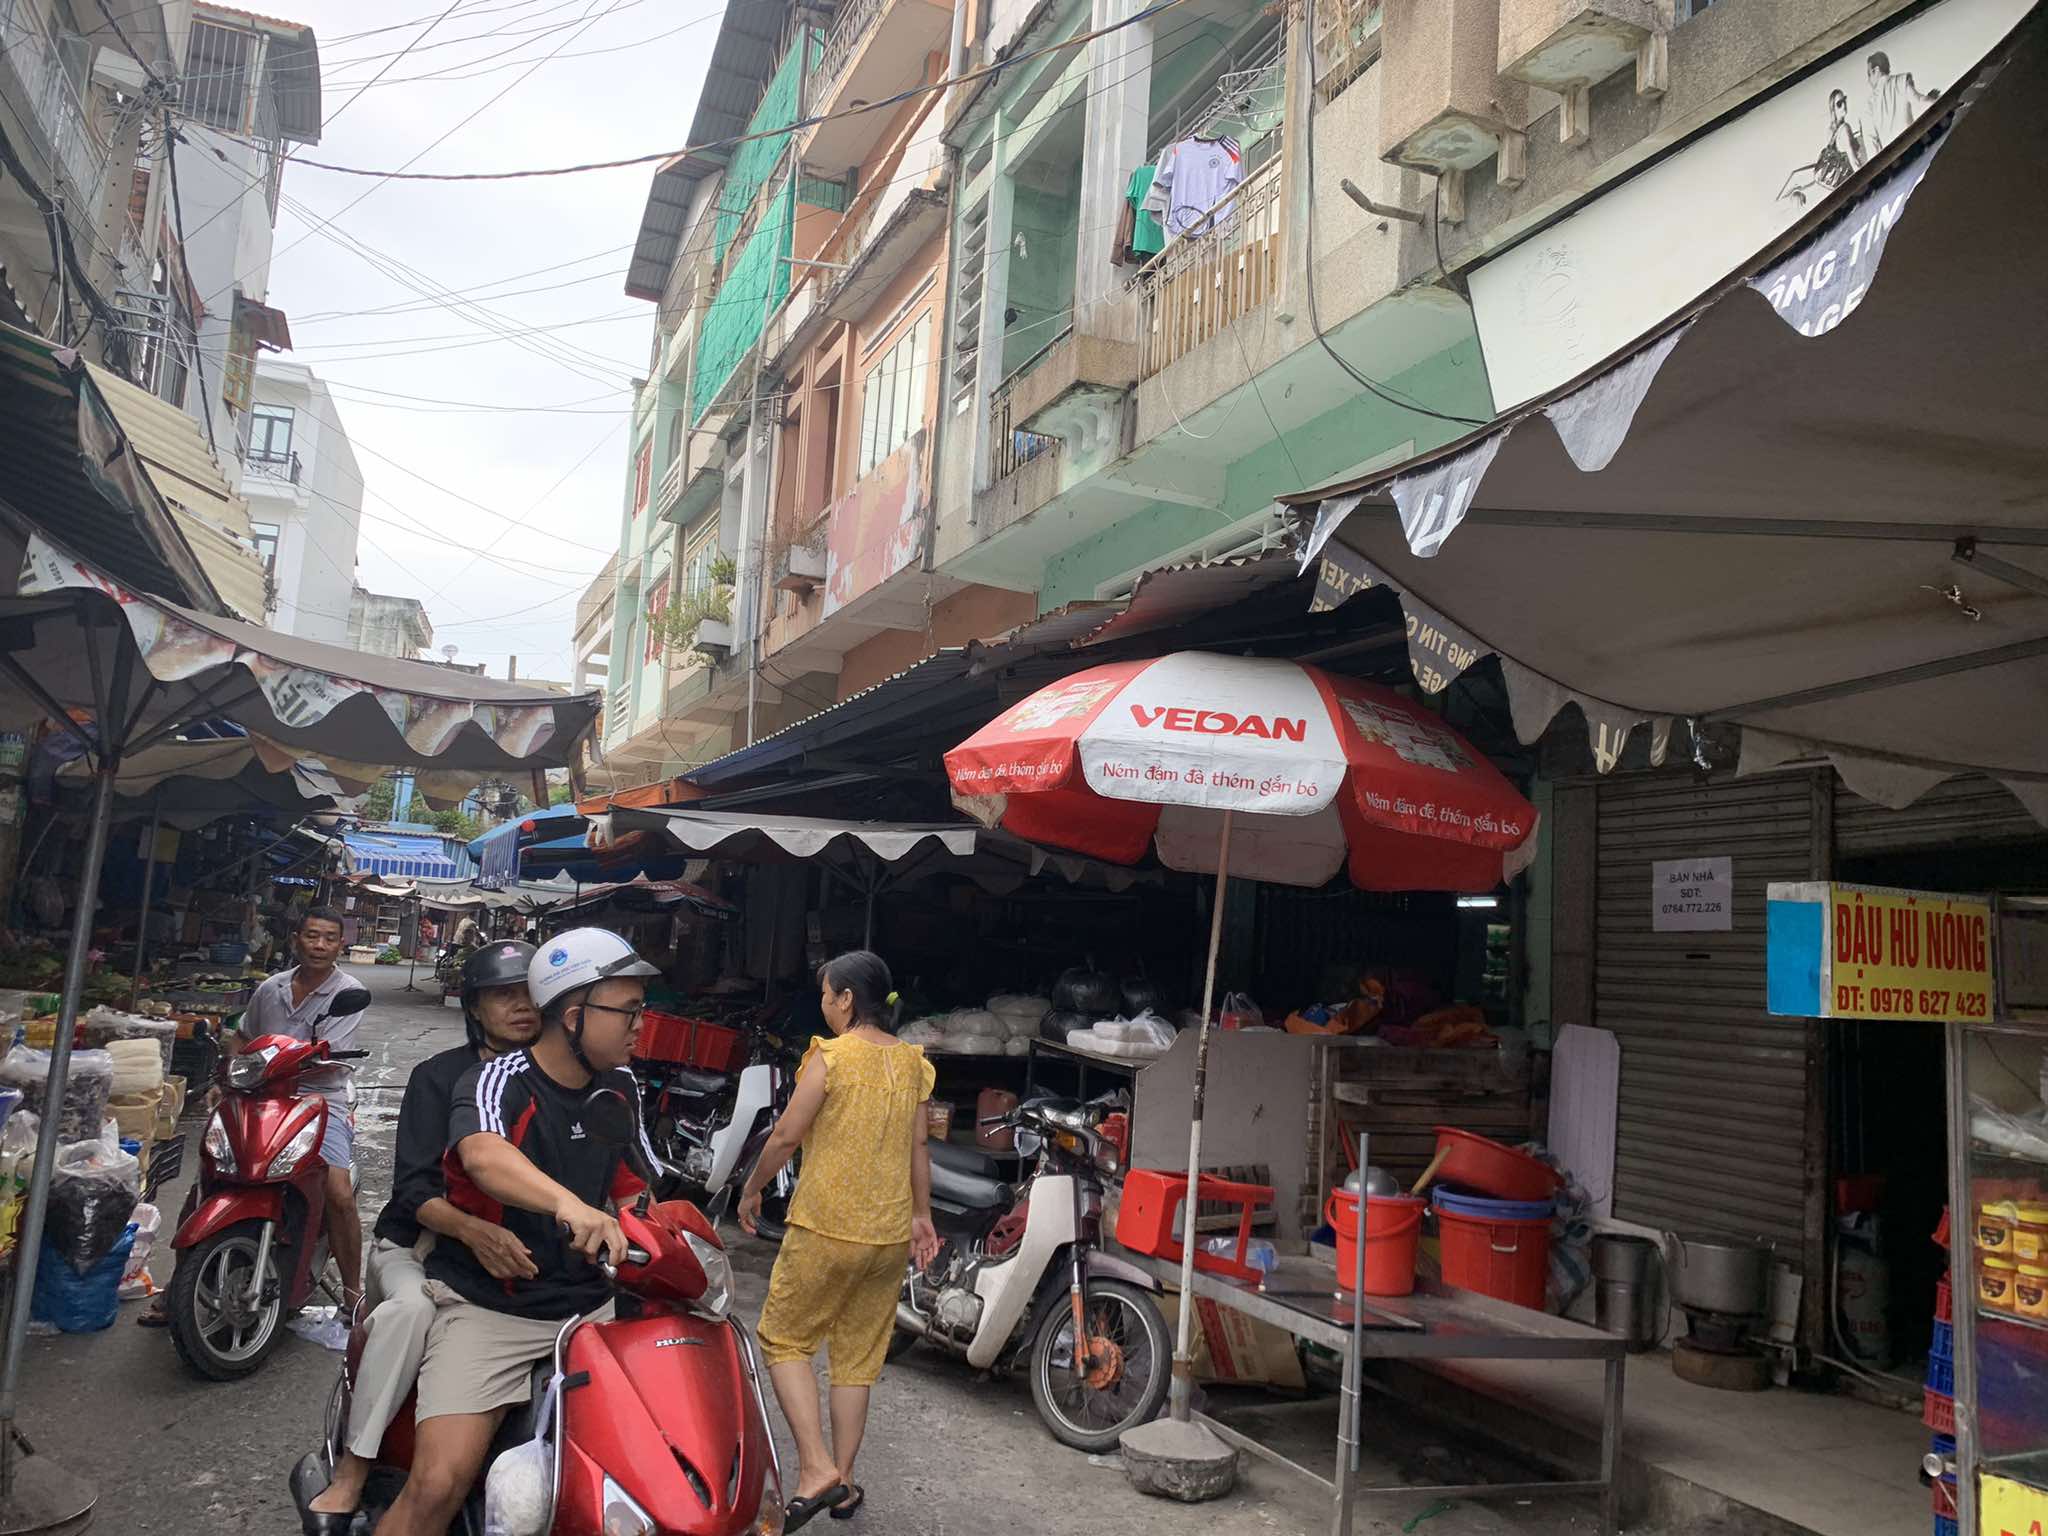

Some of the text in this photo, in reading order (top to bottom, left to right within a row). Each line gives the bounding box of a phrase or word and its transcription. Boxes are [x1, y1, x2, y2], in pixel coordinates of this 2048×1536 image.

[1849, 192, 1905, 267] TIN
[1130, 704, 1307, 742] VEDAN
[1212, 771, 1255, 791] thêm
[1258, 774, 1292, 797] gắn
[1296, 778, 1319, 798] bó
[1500, 818, 1521, 837] bó
[1837, 892, 1986, 979] ĐẬU HŨ NÓNG
[1837, 984, 1987, 1018] ĐT: 0978 627 423
